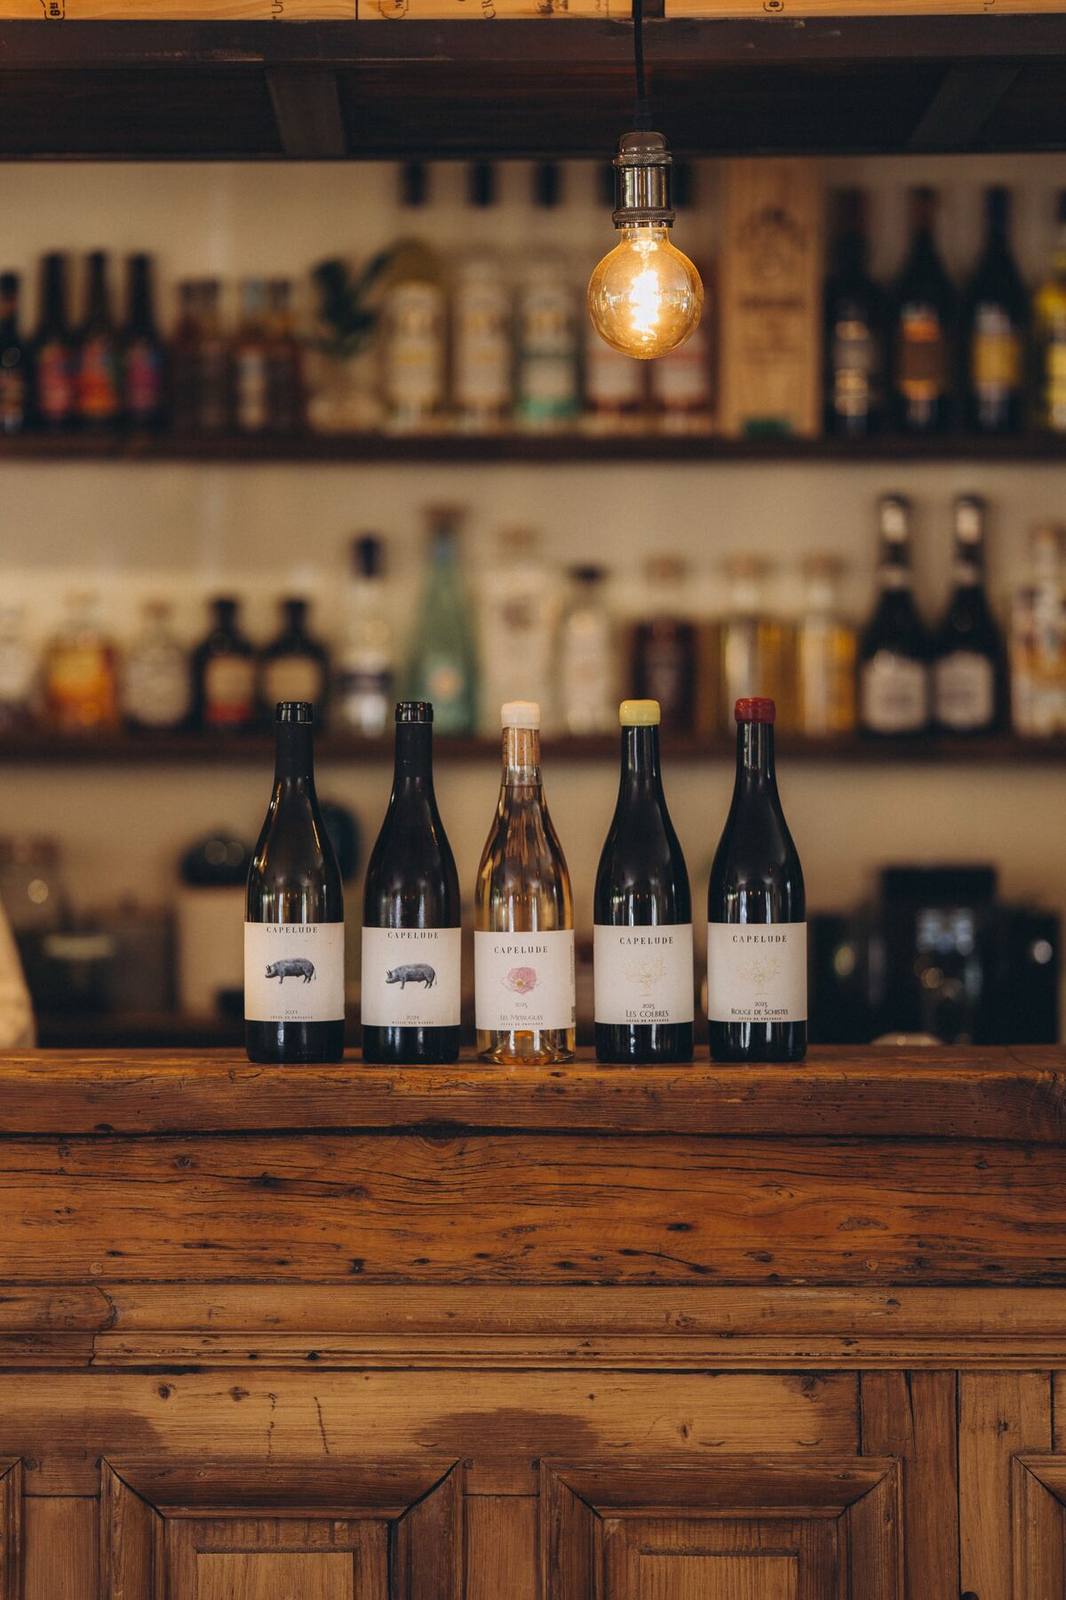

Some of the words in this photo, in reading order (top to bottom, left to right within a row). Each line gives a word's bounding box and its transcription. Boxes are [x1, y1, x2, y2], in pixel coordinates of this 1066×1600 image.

[266, 926, 319, 934] CAPELUDE
[387, 931, 439, 939] CAPELUDE
[732, 935, 787, 943] CAPELUDE
[619, 936, 674, 945] CAPELUDE
[494, 945, 549, 954] CAPELUDE
